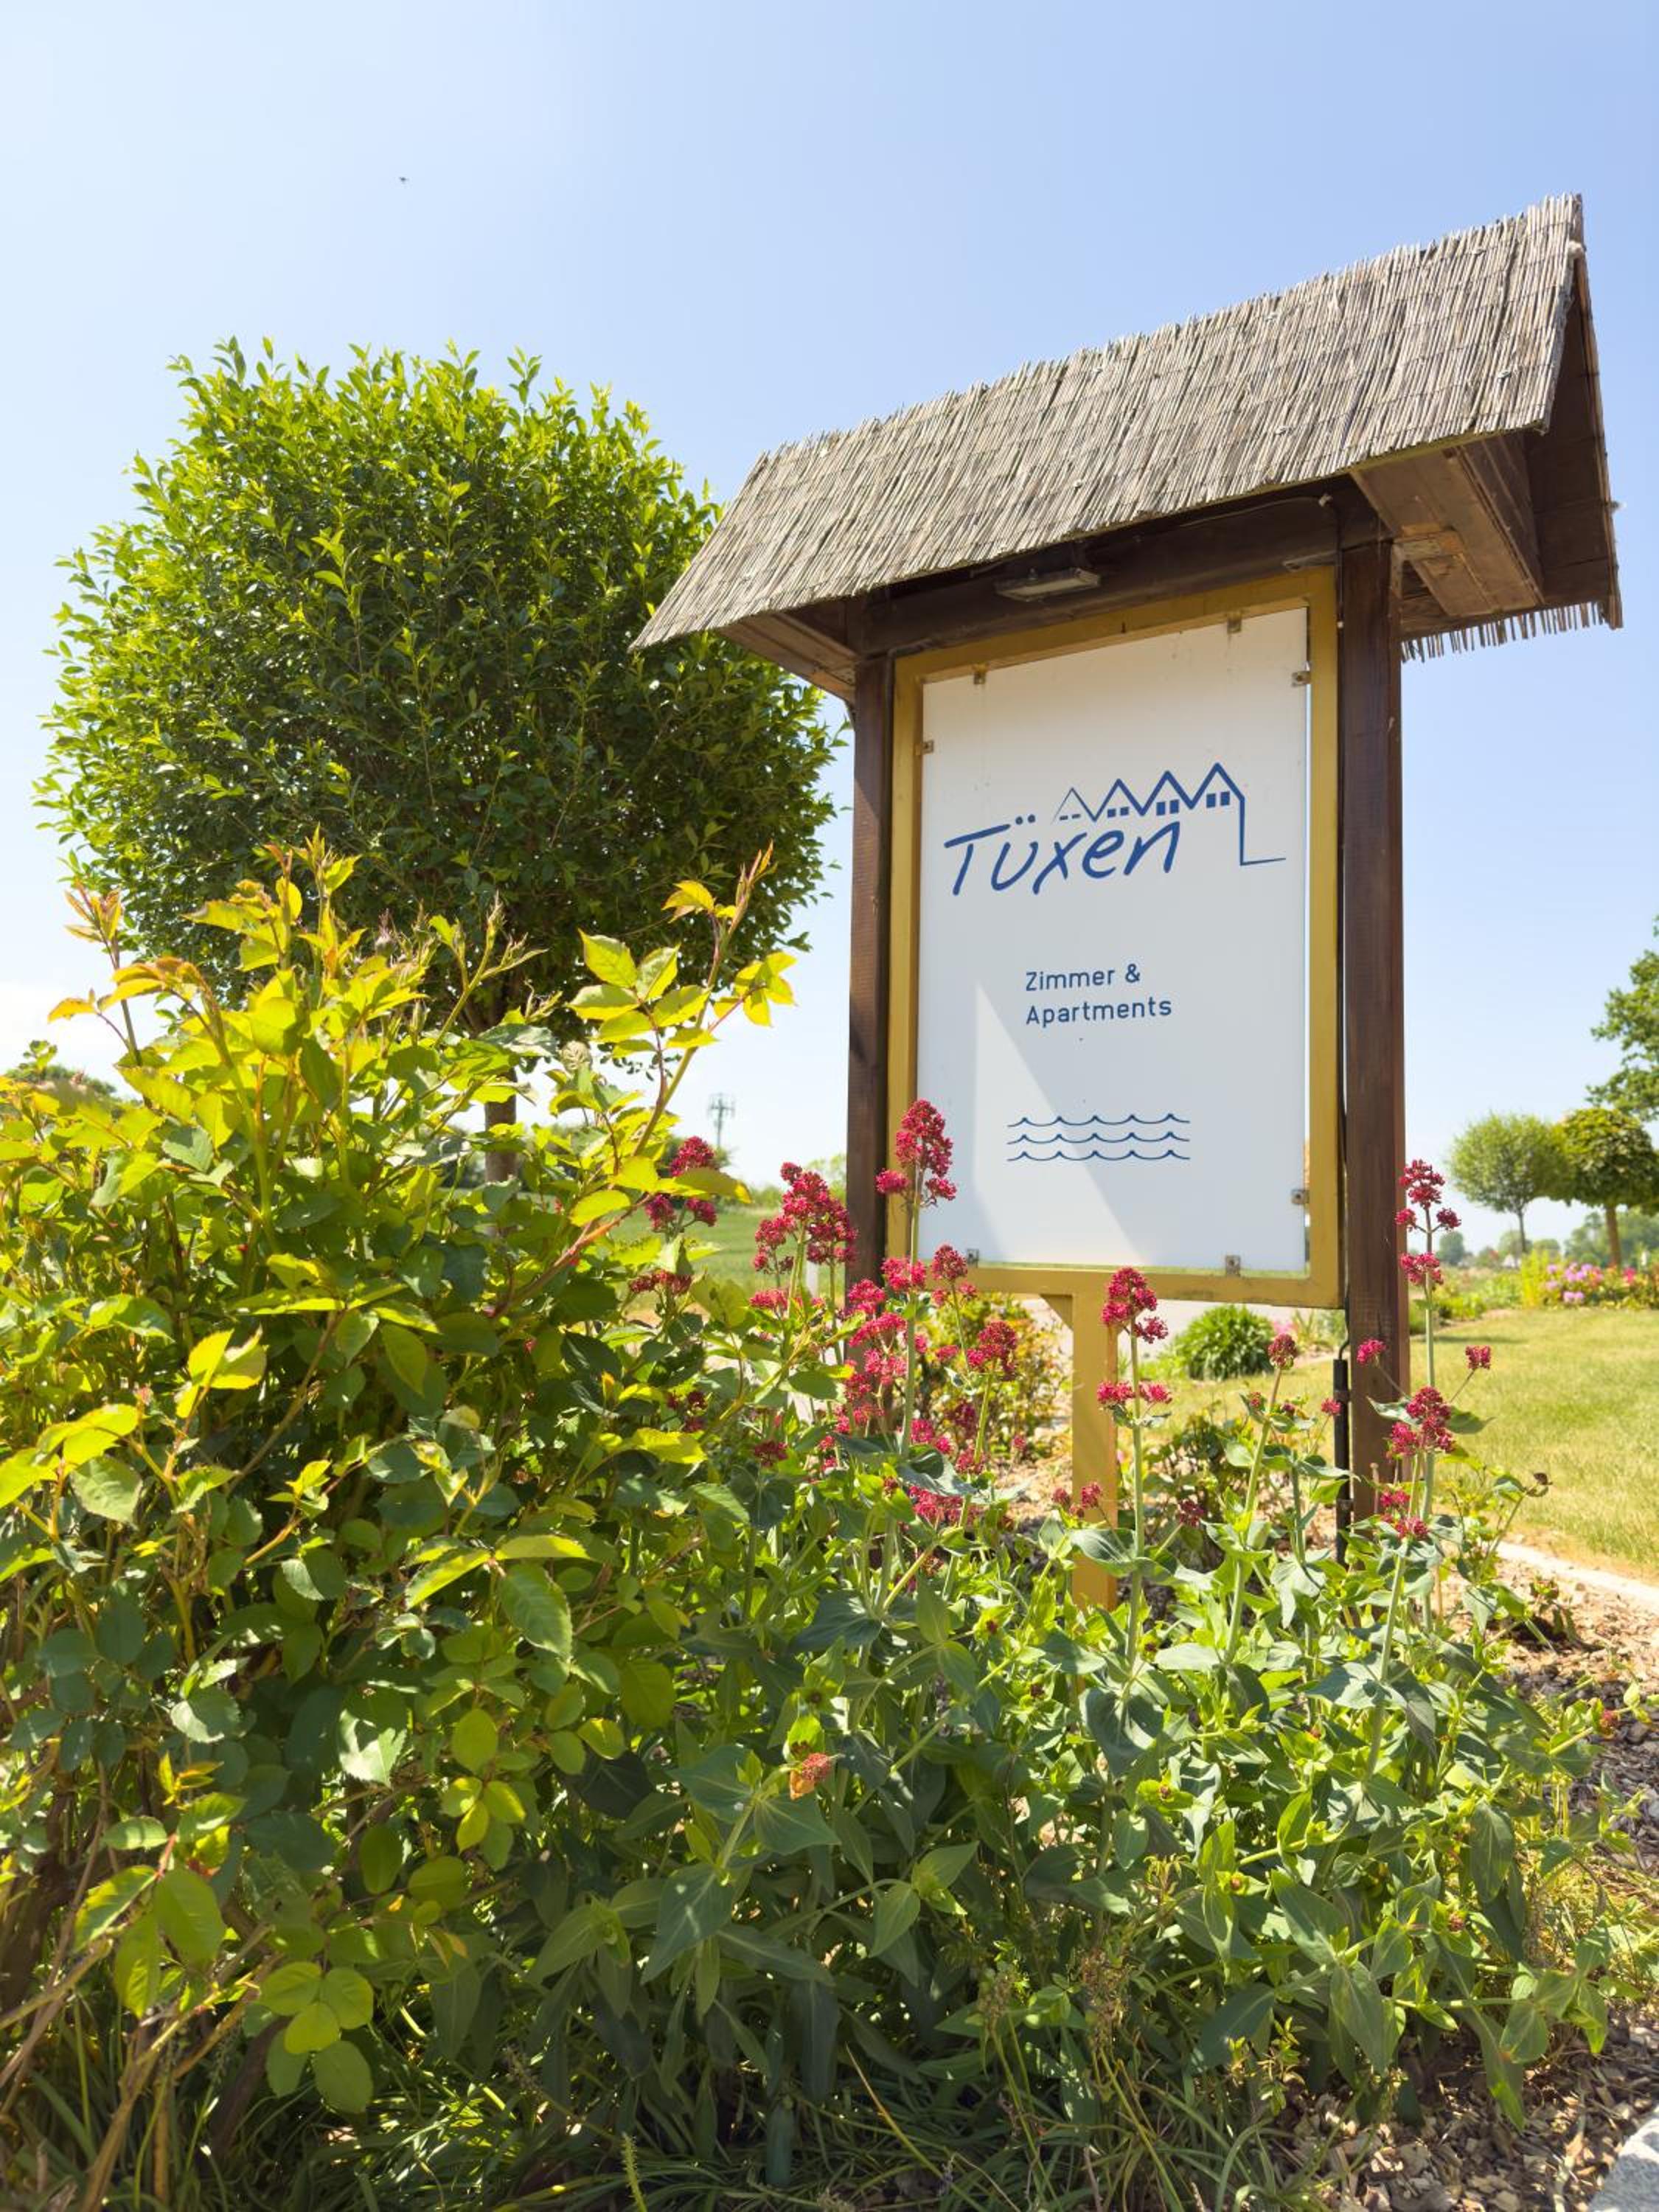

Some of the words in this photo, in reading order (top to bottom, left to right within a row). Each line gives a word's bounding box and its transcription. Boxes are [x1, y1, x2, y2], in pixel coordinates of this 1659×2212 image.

[943, 814, 1180, 896] Tüxen
[1026, 969, 1116, 992] Zimmer
[1124, 963, 1141, 983] &
[1026, 996, 1172, 1029] Apartments
